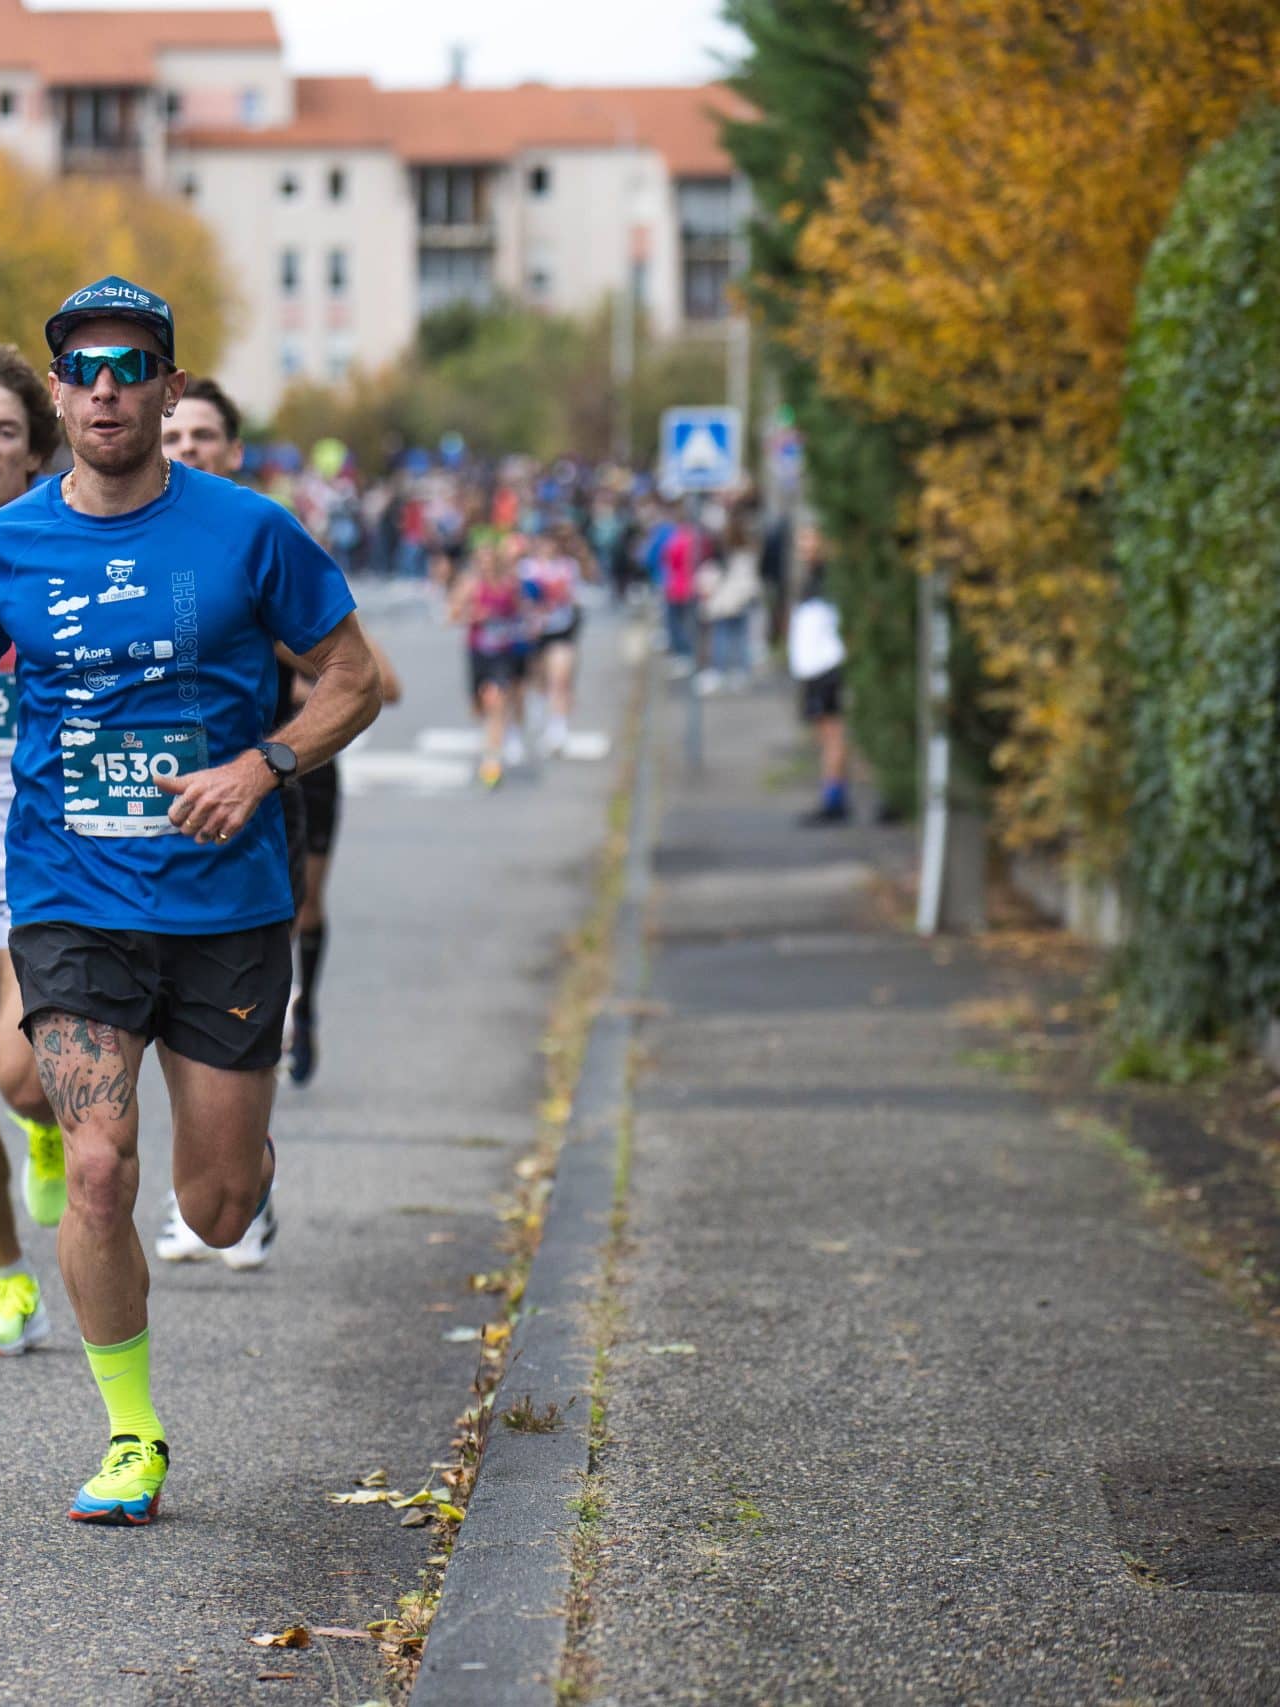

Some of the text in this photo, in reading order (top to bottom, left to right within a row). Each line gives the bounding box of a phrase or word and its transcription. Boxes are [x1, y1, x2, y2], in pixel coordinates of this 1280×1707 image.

[74, 286, 151, 305] Oxsitis
[84, 648, 112, 659] ADPS
[163, 735, 173, 743] 10
[91, 752, 179, 782] 1530
[108, 785, 162, 798] MICKAEL
